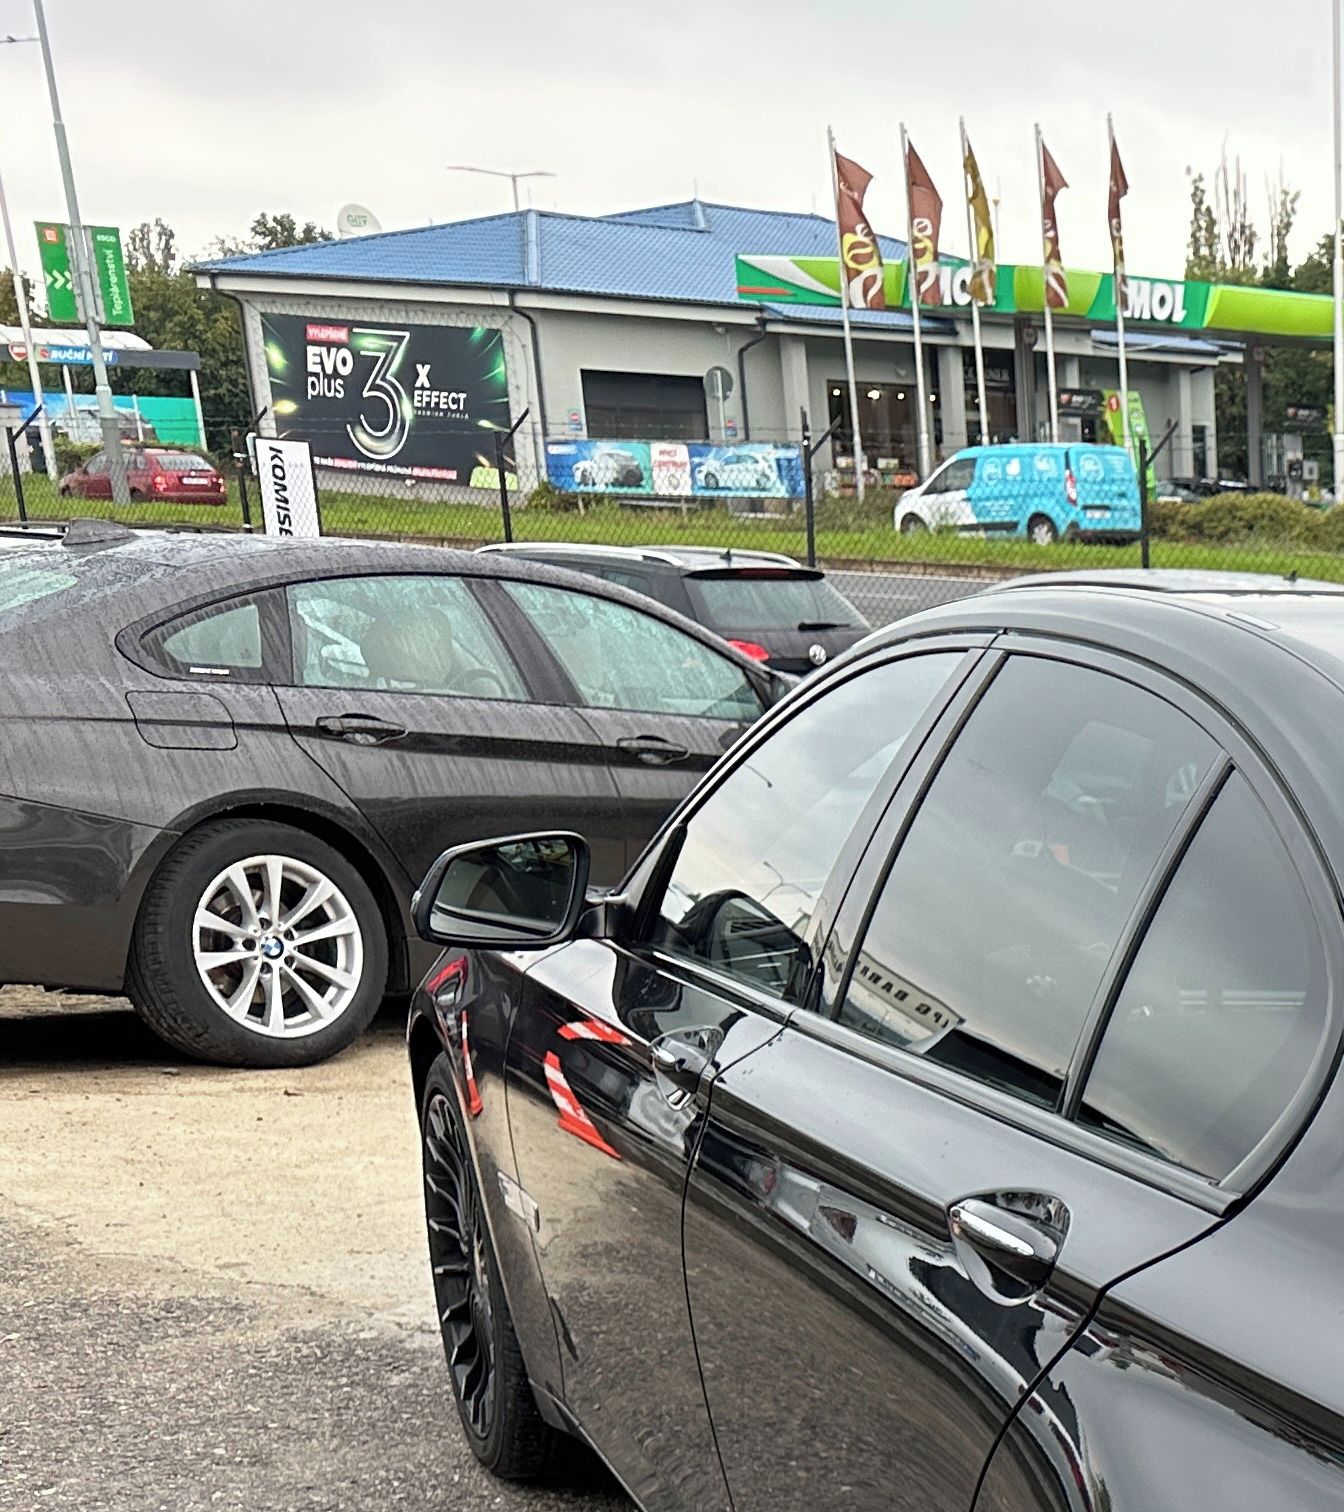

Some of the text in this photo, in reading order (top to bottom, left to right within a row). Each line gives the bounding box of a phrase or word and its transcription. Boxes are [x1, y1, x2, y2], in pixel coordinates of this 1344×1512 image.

[1127, 279, 1186, 323] MOL
[307, 345, 353, 375] EVO
[307, 371, 345, 400] plus
[415, 364, 431, 388] X
[347, 327, 410, 460] 3
[413, 390, 468, 410] EFFECT
